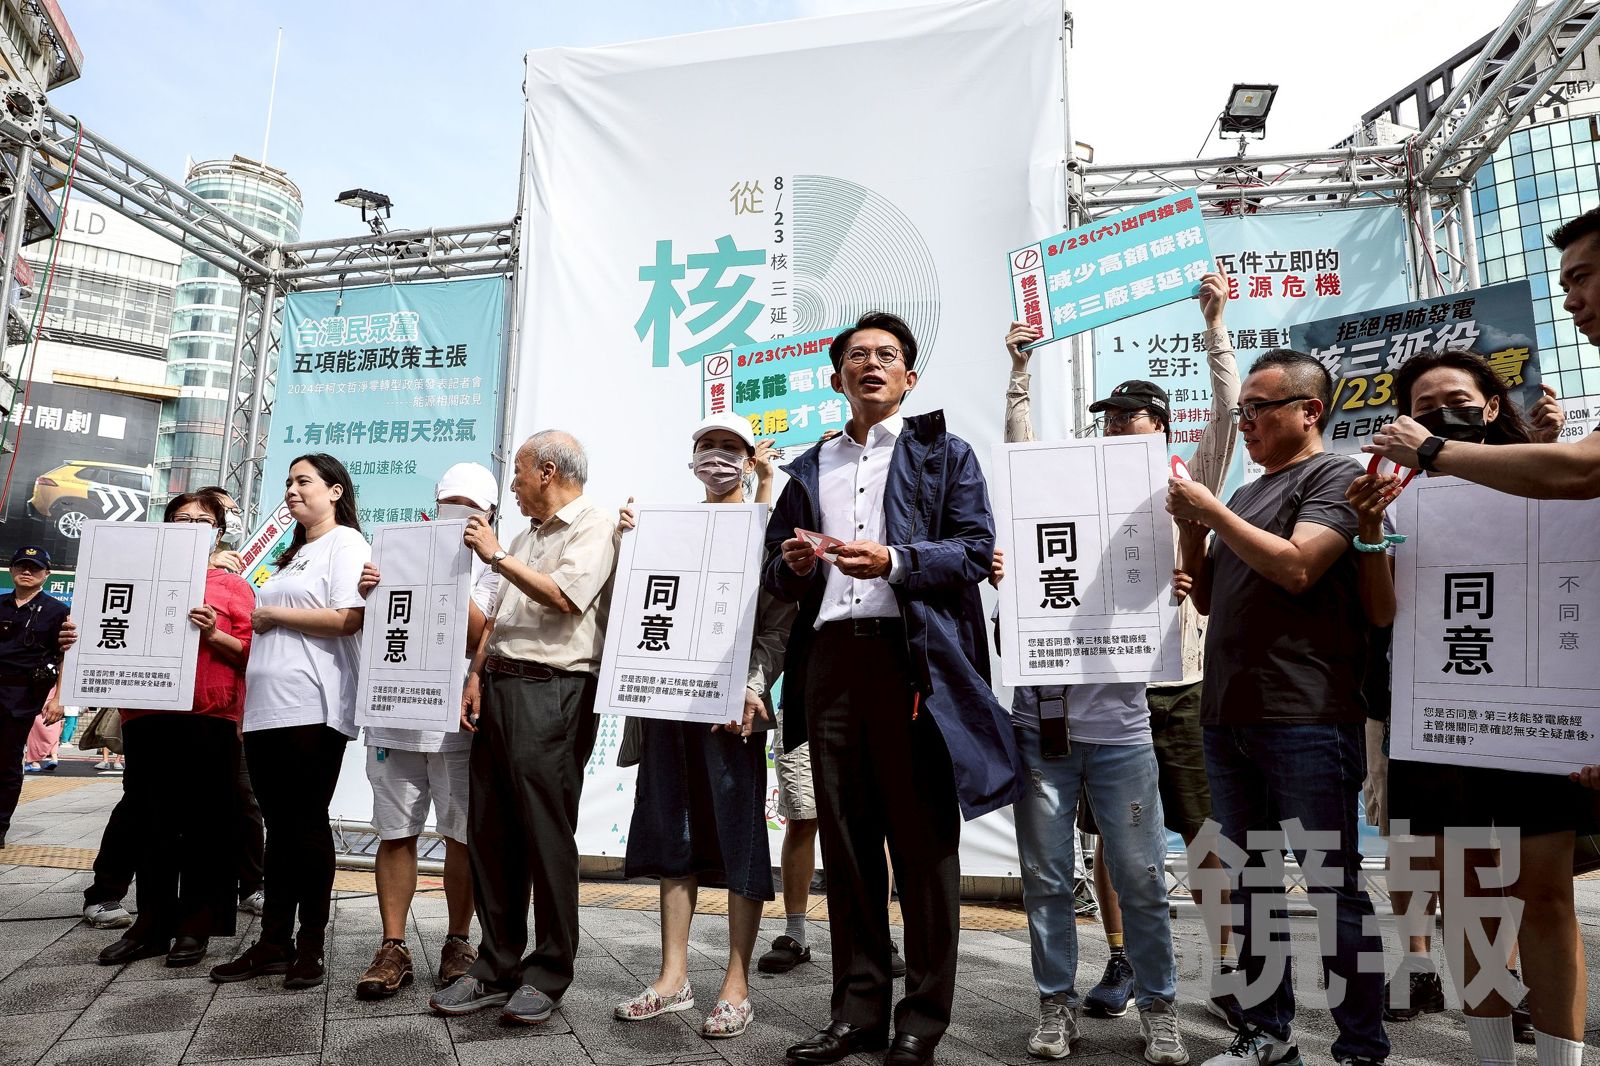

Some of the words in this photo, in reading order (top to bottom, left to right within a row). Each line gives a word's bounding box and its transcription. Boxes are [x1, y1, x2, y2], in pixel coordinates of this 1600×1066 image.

[729, 180, 764, 216] 從
[1047, 197, 1194, 257] 8/23(六)出門投票
[770, 176, 788, 340] 8/23核三延
[1048, 226, 1204, 292] 減少高額碳稅
[634, 234, 766, 367] 核
[1336, 297, 1476, 342] 拒絕用肺發電
[296, 311, 420, 348] 台灣民眾黨
[293, 344, 467, 374] 五項能源政策主張
[710, 382, 726, 414] 核三
[283, 418, 477, 446] 1.有條件使用天然氣
[1036, 522, 1080, 609] 同意
[1123, 524, 1141, 584] 不同意
[97, 583, 134, 649] 同意
[163, 589, 179, 635] 不同意
[384, 590, 412, 663] 同意
[436, 594, 448, 645] 不同意
[637, 575, 680, 651] 同意
[711, 582, 730, 635] 不同意
[1441, 571, 1494, 675] 同意
[1558, 575, 1580, 650] 不同意
[1028, 634, 1147, 647] 您是否同意，第三核能發電廠經
[1029, 645, 1156, 658] 主管機關同意確認無安全疑慮後，
[1422, 733, 1474, 746] 繼續運轉？
[1423, 707, 1583, 727] 您是否同意，第三核能發電廠經
[1423, 721, 1595, 742] 主管機關同意確認無安全疑慮後，
